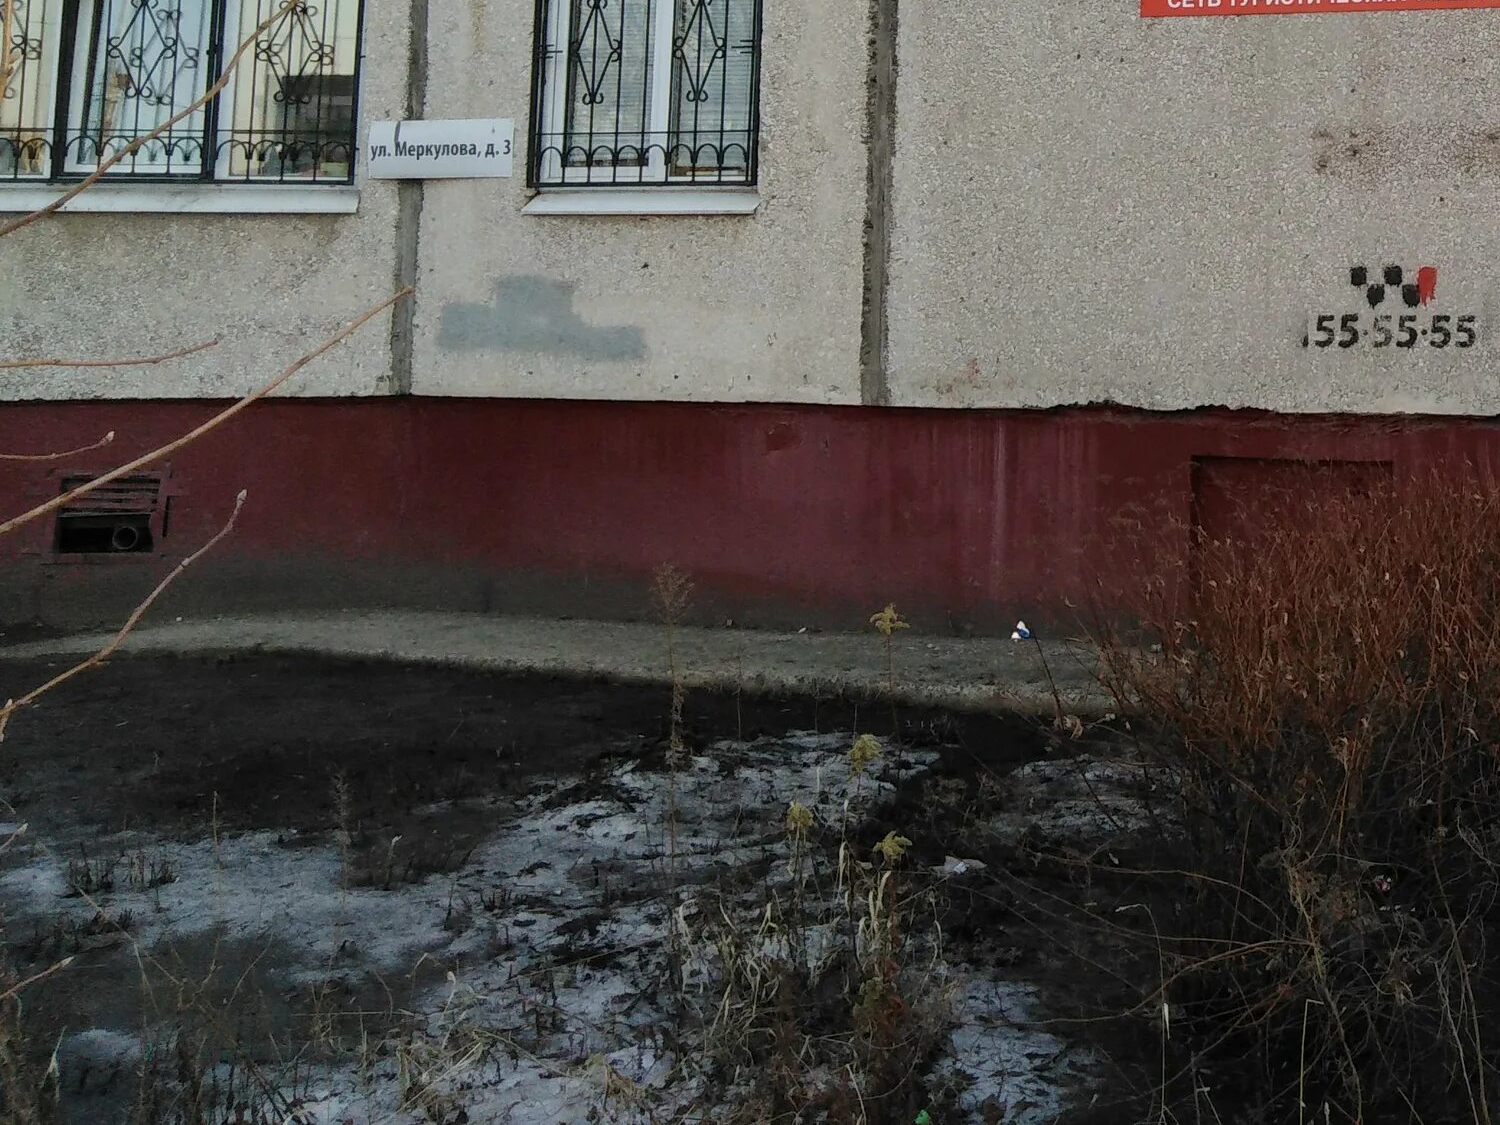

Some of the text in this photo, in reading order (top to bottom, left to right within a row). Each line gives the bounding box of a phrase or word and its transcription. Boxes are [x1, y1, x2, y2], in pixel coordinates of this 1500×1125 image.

[370, 139, 511, 160] ул. Меркулова, д. 3
